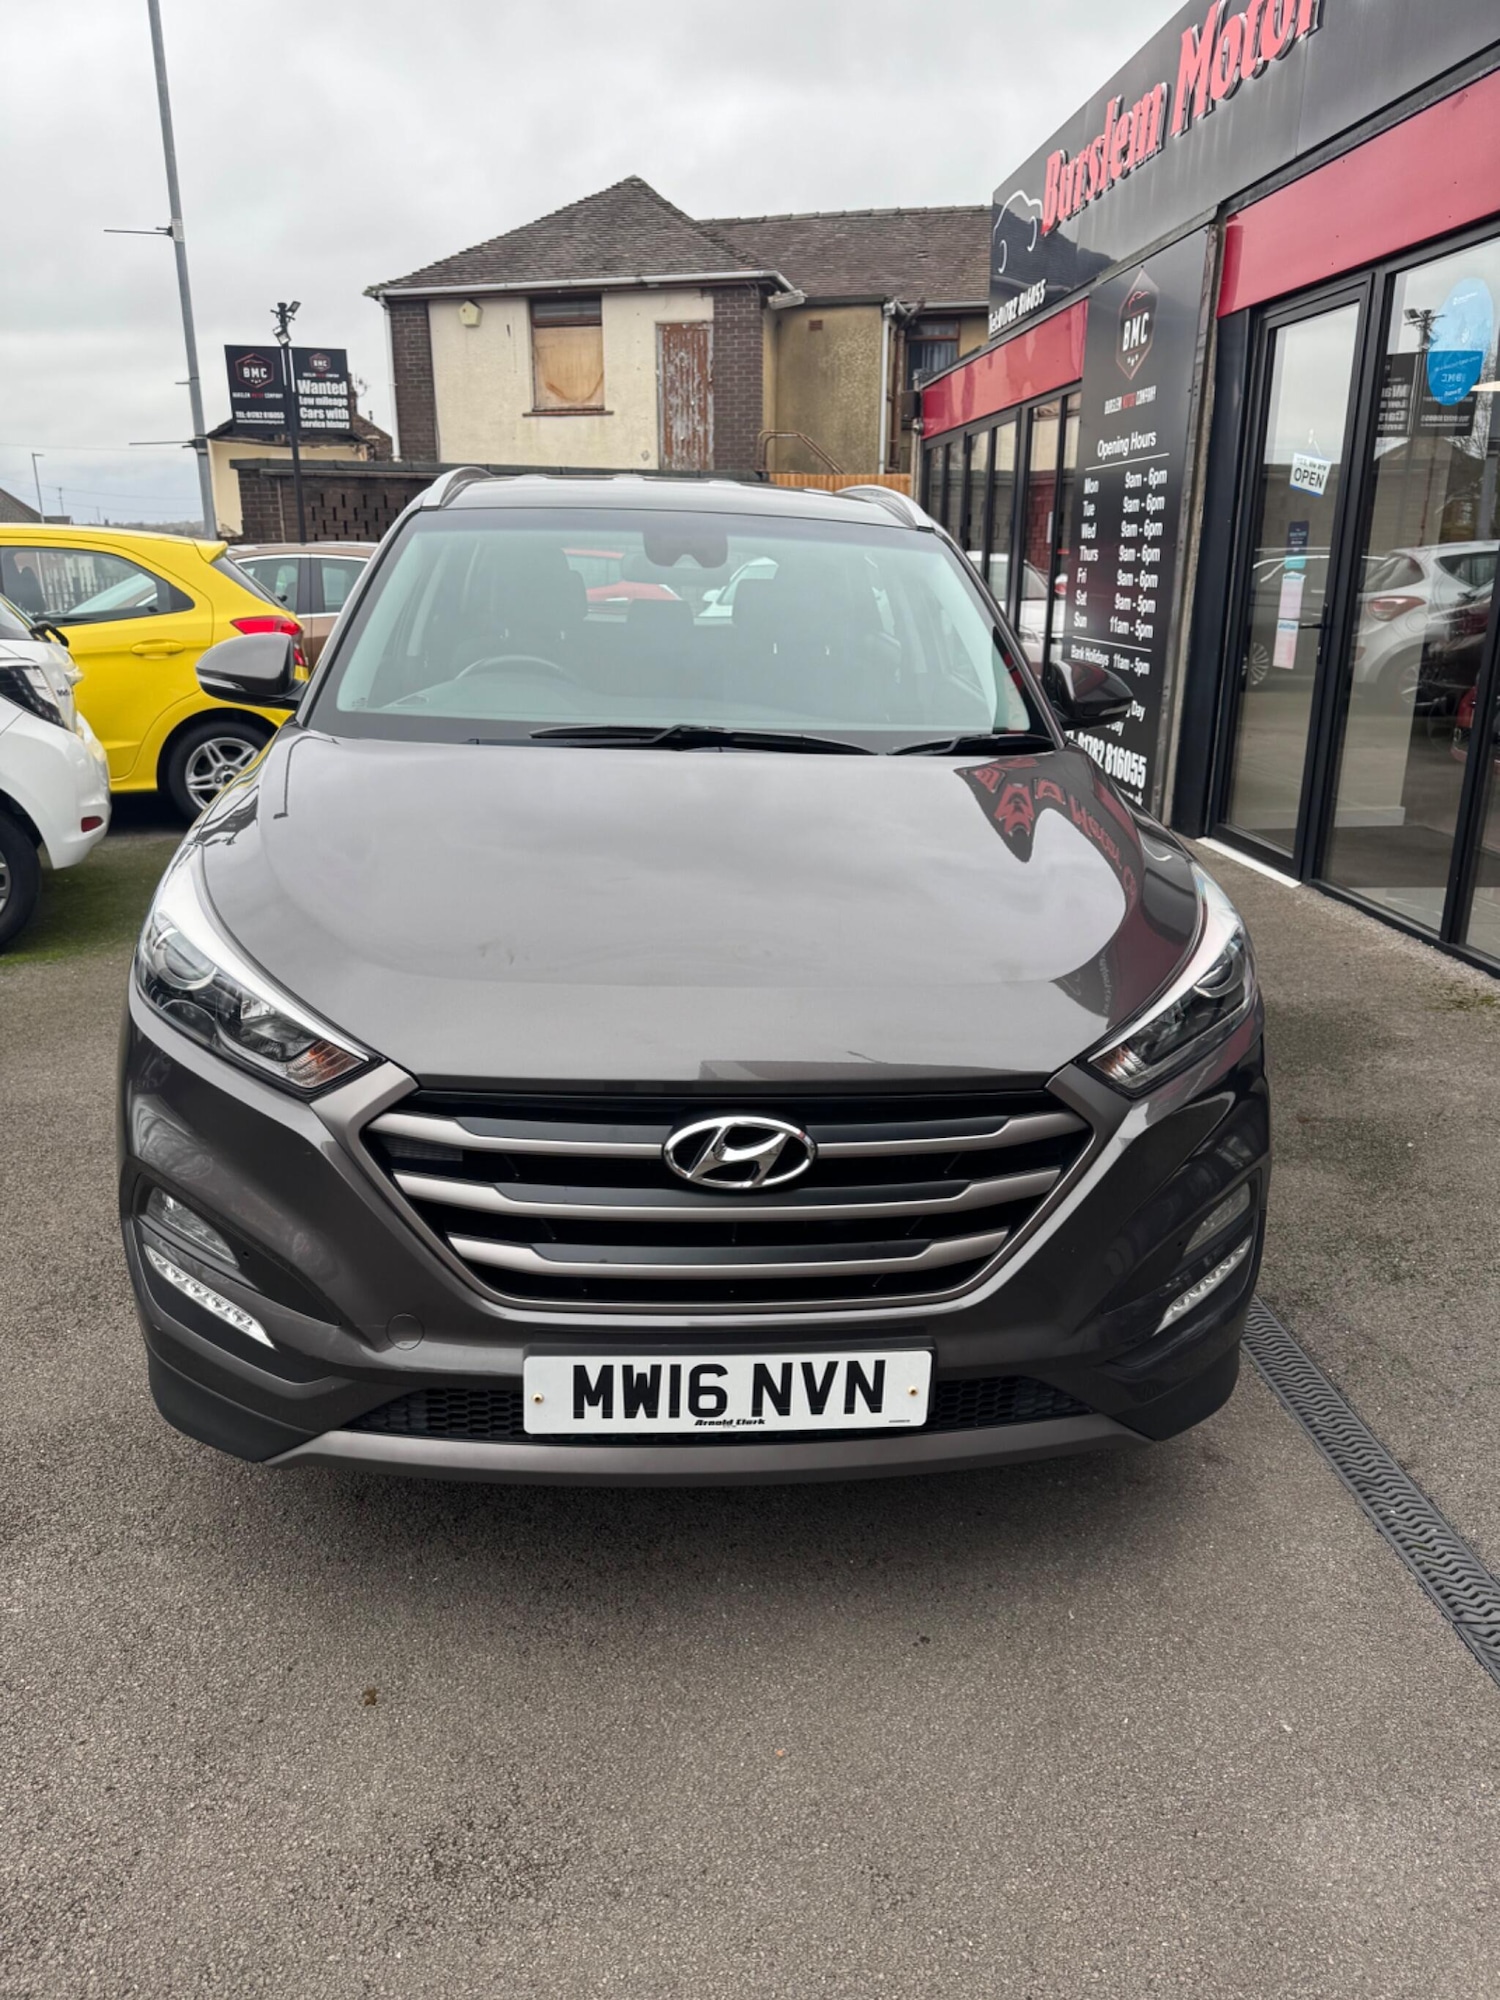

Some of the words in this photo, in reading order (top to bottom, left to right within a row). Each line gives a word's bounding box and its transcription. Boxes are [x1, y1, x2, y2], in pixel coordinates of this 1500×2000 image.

[1041, 82, 1167, 236] Burslem
[1122, 312, 1149, 352] BMC
[243, 367, 267, 378] BMC
[297, 379, 348, 396] Wanted
[298, 396, 314, 406] Low
[315, 396, 348, 407] mileage
[300, 407, 325, 419] Cars
[325, 408, 349, 420] with
[300, 420, 325, 429] service
[326, 420, 350, 430] history
[1097, 436, 1129, 461] Opening
[1130, 431, 1157, 451] Hours
[1083, 478, 1099, 495] Mon
[1125, 471, 1142, 489] 9am
[1148, 467, 1168, 489] 6pm
[1294, 467, 1325, 488] OPEN
[1083, 501, 1096, 517] Tue
[1122, 496, 1140, 513] 9am
[1146, 493, 1166, 515] 6pm
[1081, 522, 1097, 539] Wed
[1121, 520, 1138, 537] 9am
[1144, 519, 1163, 541] 6pm
[1079, 545, 1099, 561] Thurs
[1118, 544, 1136, 561] 9am
[1141, 544, 1161, 566] 6pm
[1076, 567, 1087, 584] Fri
[1117, 569, 1134, 586] 9am
[1139, 569, 1158, 592] 6pm
[1075, 589, 1087, 606] Sat
[1114, 592, 1131, 611] 9am
[1137, 594, 1156, 617] 5pm
[1074, 611, 1087, 628] Sun
[1110, 616, 1130, 635] 11am
[1134, 619, 1154, 641] 5pm
[1085, 647, 1109, 668] Holidays
[1113, 653, 1131, 671] 11am
[1134, 657, 1150, 677] 5pm
[1131, 700, 1146, 722] Day
[1105, 743, 1147, 789] 816055
[573, 1363, 729, 1419] MW16
[751, 1359, 886, 1417] NVN
